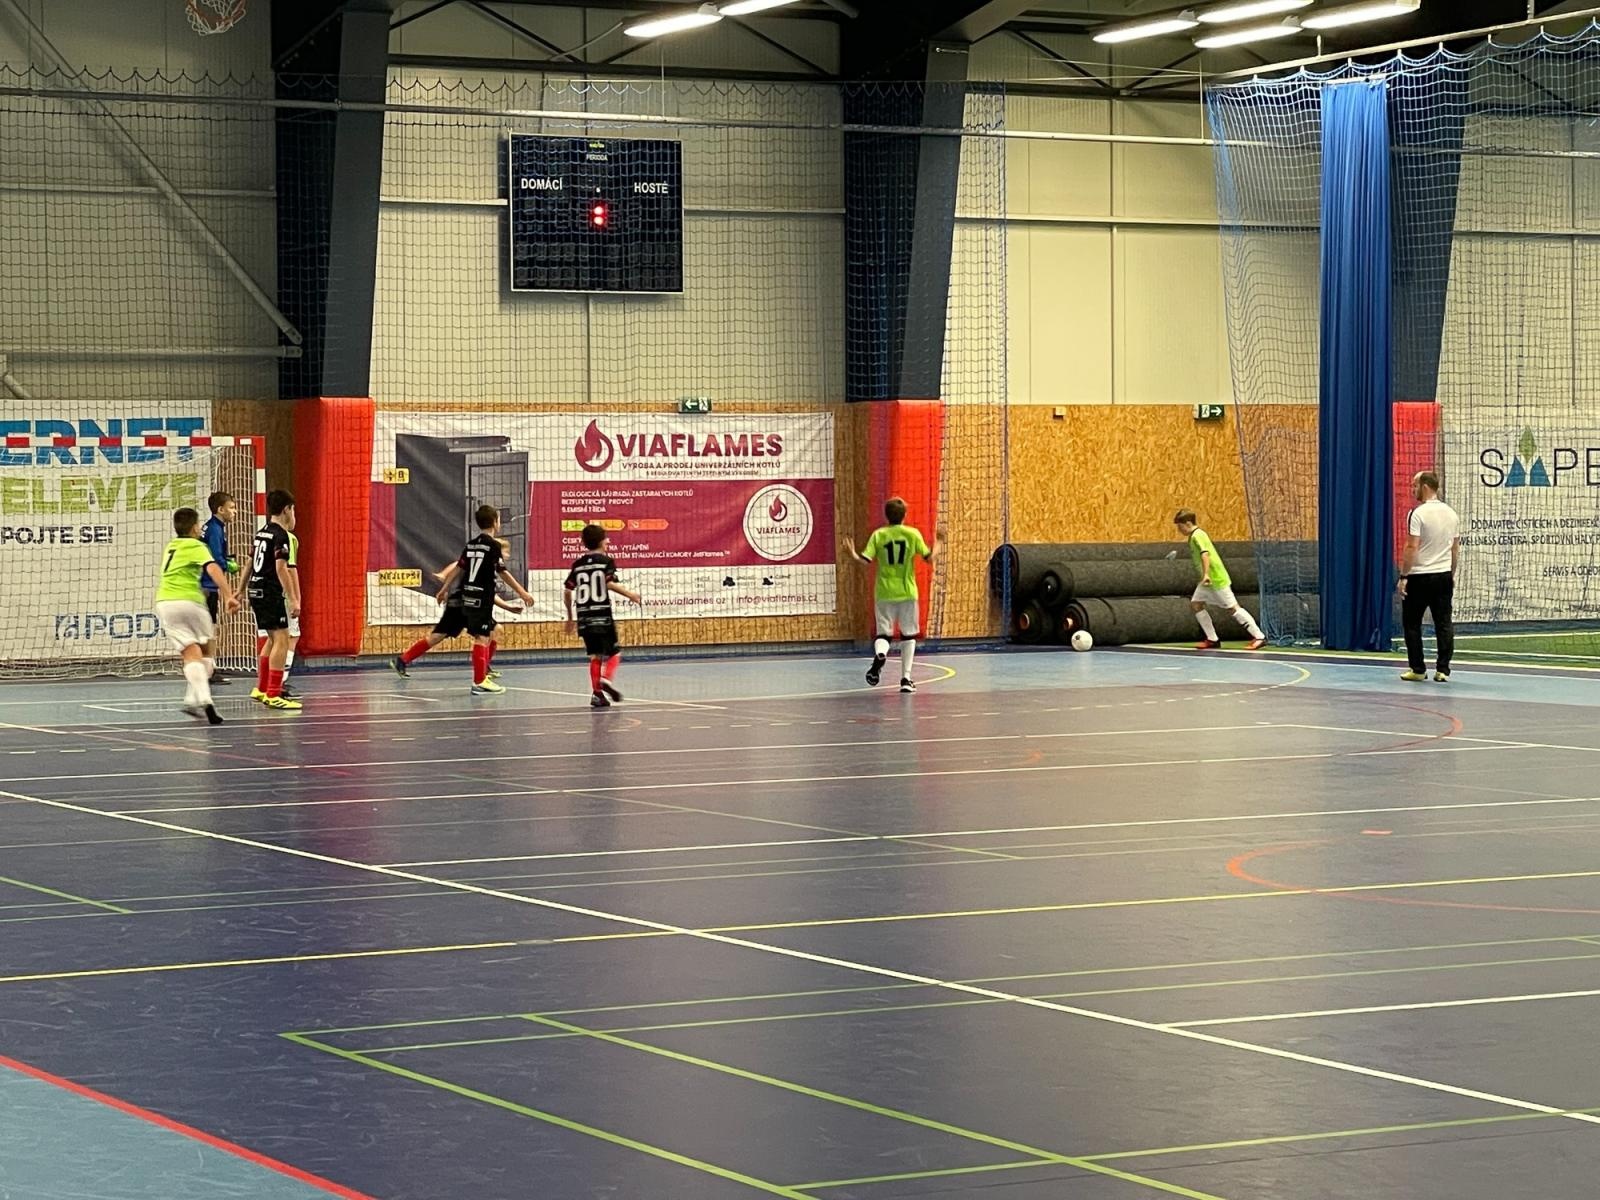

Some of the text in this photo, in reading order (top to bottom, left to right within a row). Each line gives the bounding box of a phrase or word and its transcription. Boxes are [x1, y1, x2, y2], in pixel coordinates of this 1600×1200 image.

[521, 177, 563, 190] DOMÁCÍ
[616, 433, 783, 457] VIAFLAMES
[663, 461, 693, 469] PRODEJ
[2, 473, 198, 514] ELEVIZE
[1, 526, 114, 545] POJTE SE!
[756, 526, 801, 535] VIAFLAMES
[883, 540, 908, 566] 17
[575, 570, 608, 605] 60
